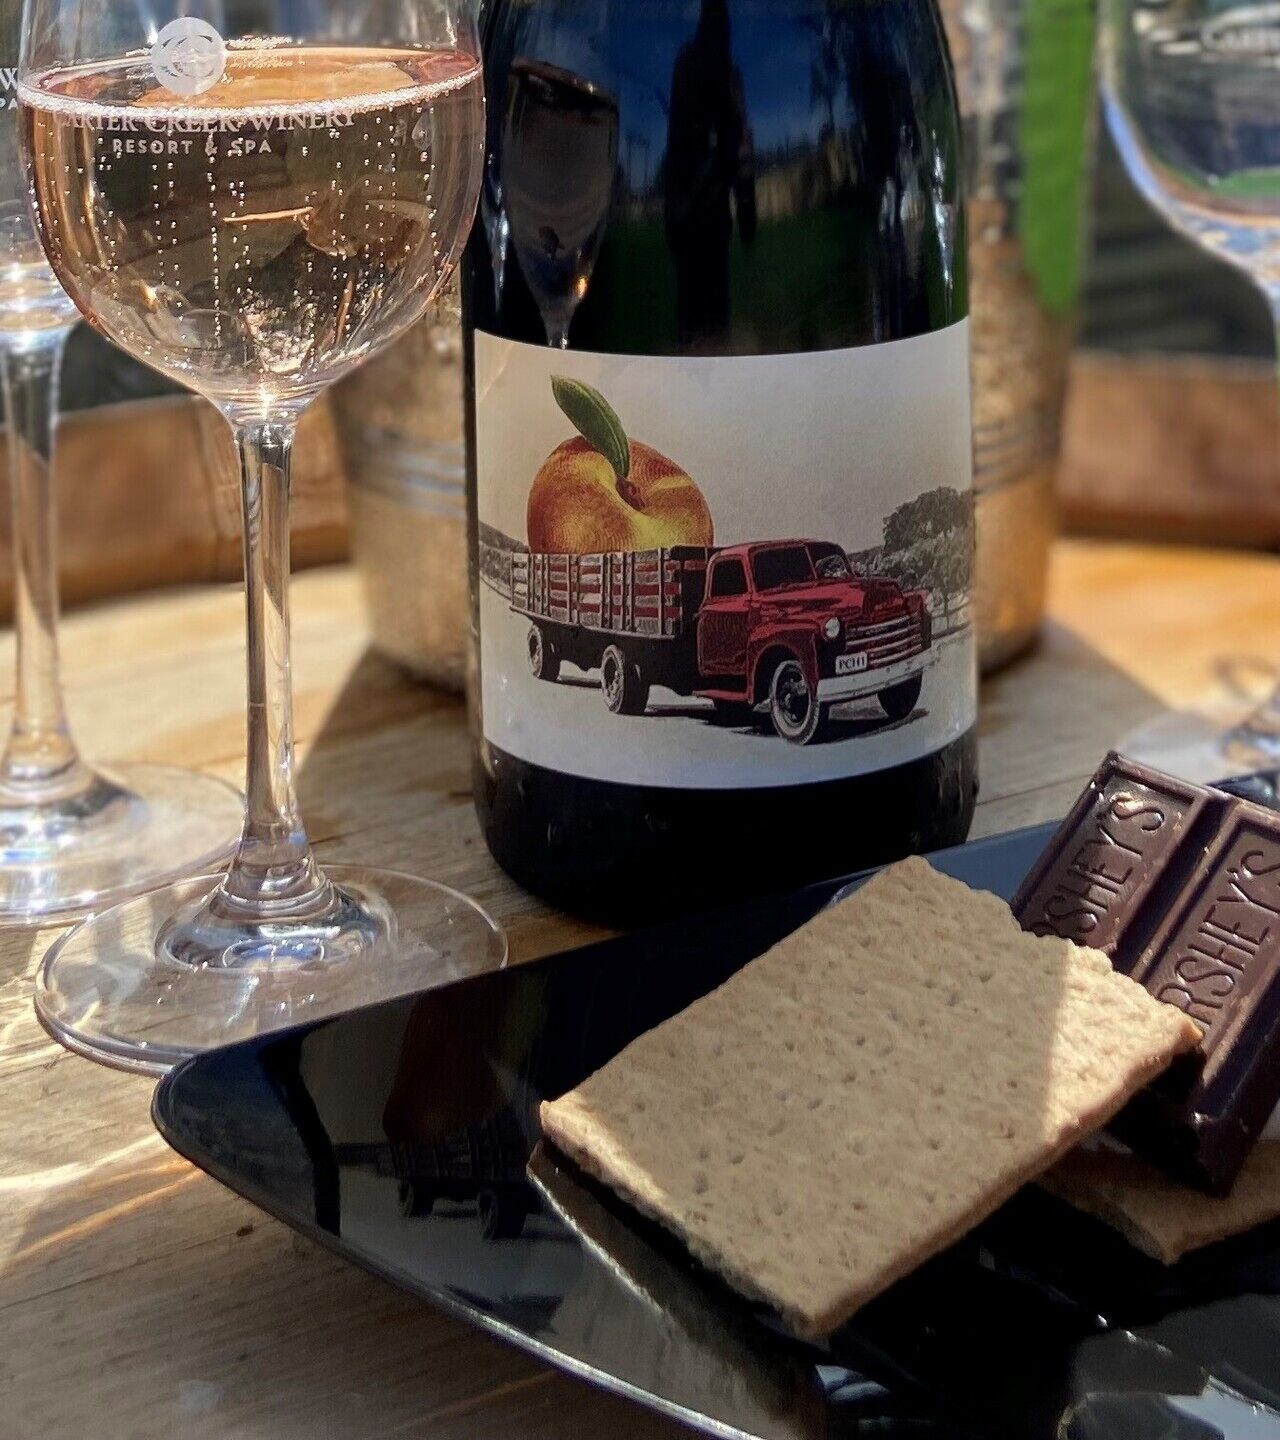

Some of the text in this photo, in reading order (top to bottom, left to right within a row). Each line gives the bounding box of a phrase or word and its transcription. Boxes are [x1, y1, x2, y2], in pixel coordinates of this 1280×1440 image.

[247, 107, 357, 132] WINERY
[111, 138, 194, 155] RESORT
[230, 137, 272, 155] SPA
[1038, 795, 1166, 935] SHEY'S
